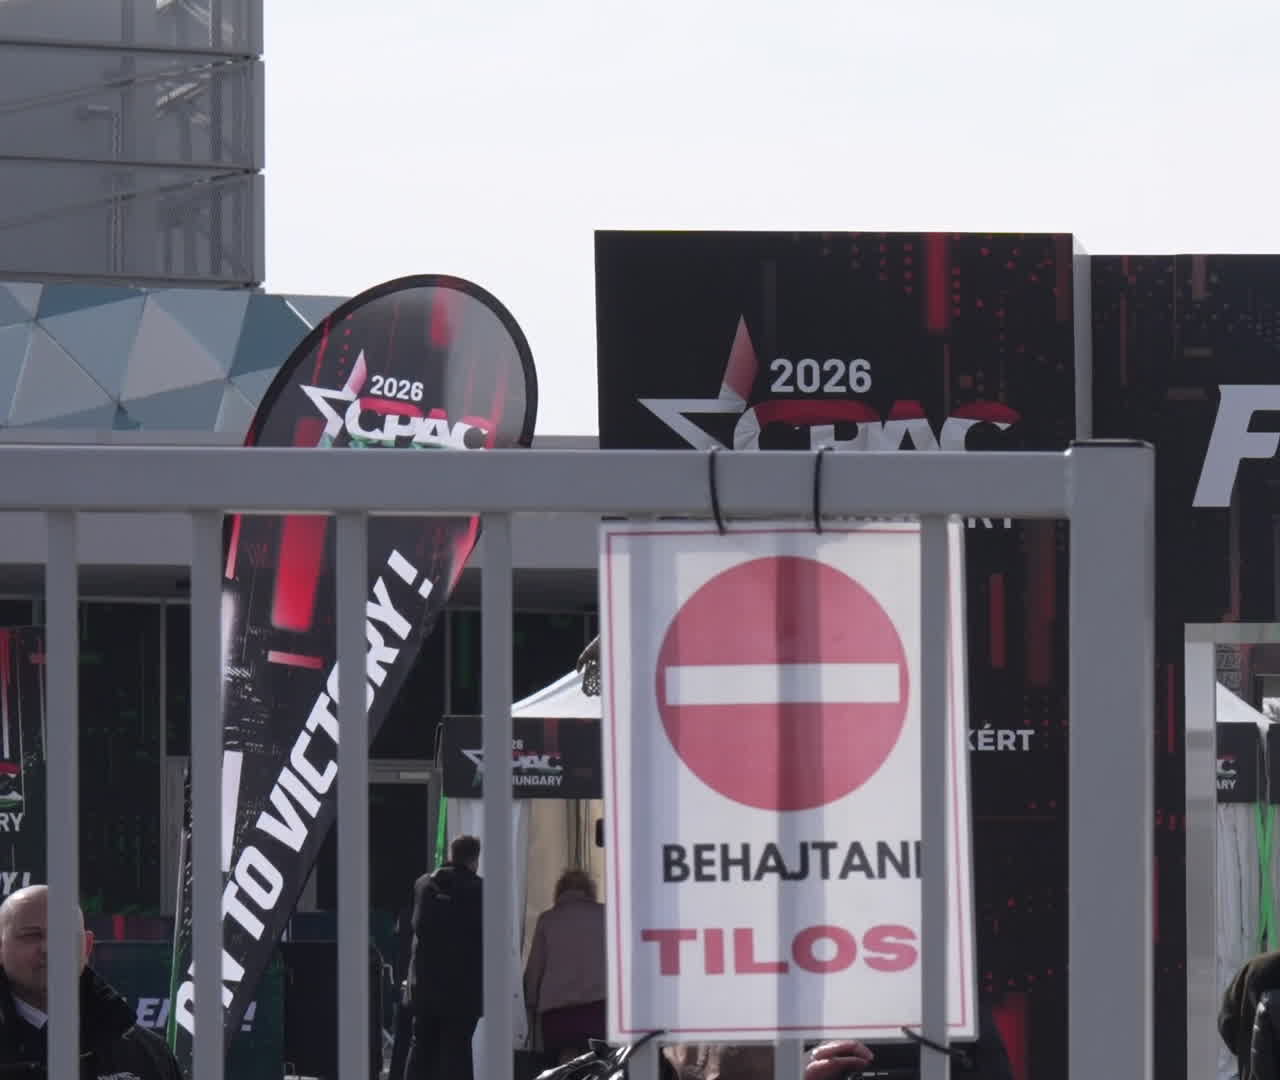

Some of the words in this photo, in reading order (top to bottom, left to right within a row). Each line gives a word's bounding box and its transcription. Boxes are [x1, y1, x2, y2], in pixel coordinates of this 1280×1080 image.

[370, 375, 424, 401] 2026
[769, 358, 873, 393] 2026
[345, 397, 492, 450] CPAC
[221, 846, 284, 940] TO
[641, 925, 918, 976] TILOS
